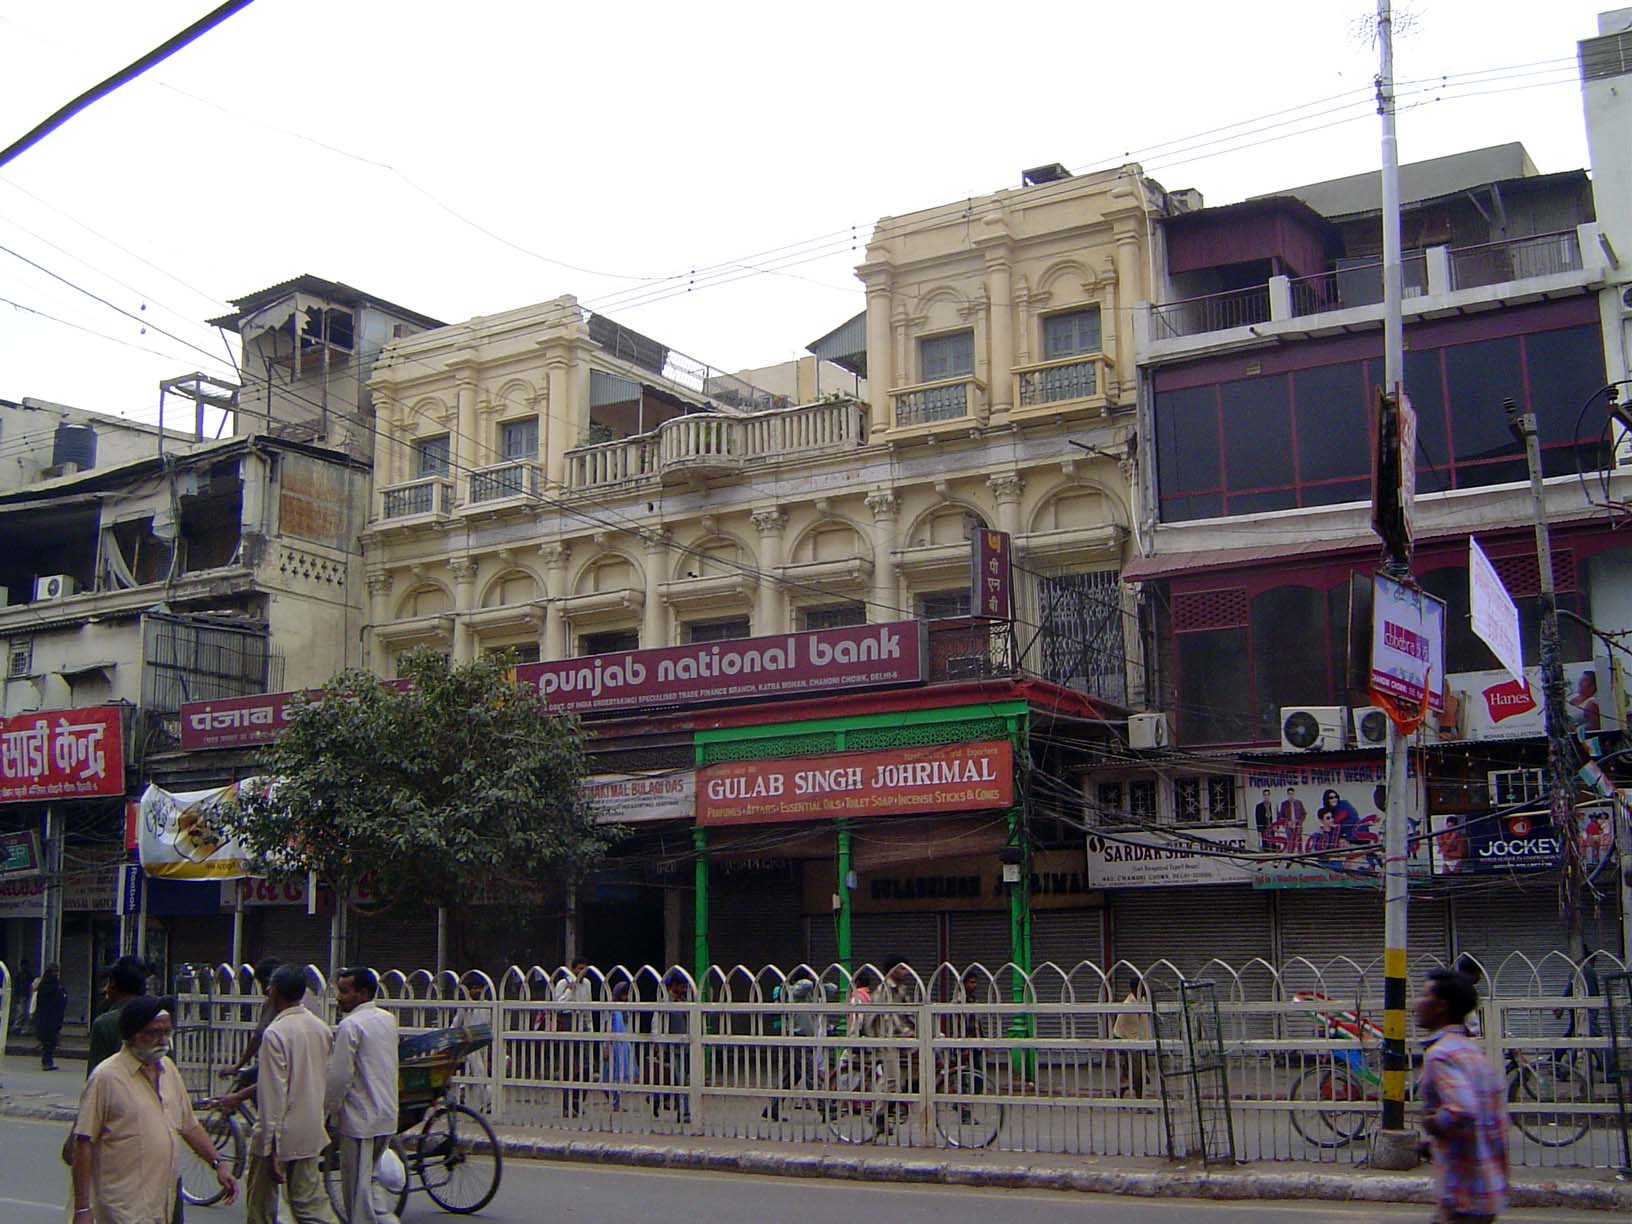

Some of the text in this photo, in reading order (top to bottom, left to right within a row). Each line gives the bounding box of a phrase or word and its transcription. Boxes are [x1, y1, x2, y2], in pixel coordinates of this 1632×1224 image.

[538, 627, 900, 696] punjab national bank
[700, 687, 727, 698] FINANCE
[809, 676, 840, 687] CHANDNI
[1489, 691, 1531, 706] Hanes
[190, 706, 274, 731] पंजाब
[55, 717, 107, 779] केन्द्र
[707, 758, 997, 800] GULAB SINGH JOHRIMAL
[898, 792, 934, 806] INCENSE
[934, 790, 966, 804] STICKS
[967, 789, 974, 800] &
[975, 788, 1000, 801] CONES
[1103, 845, 1162, 863] SARDAR
[1479, 838, 1561, 857] JOCKEY
